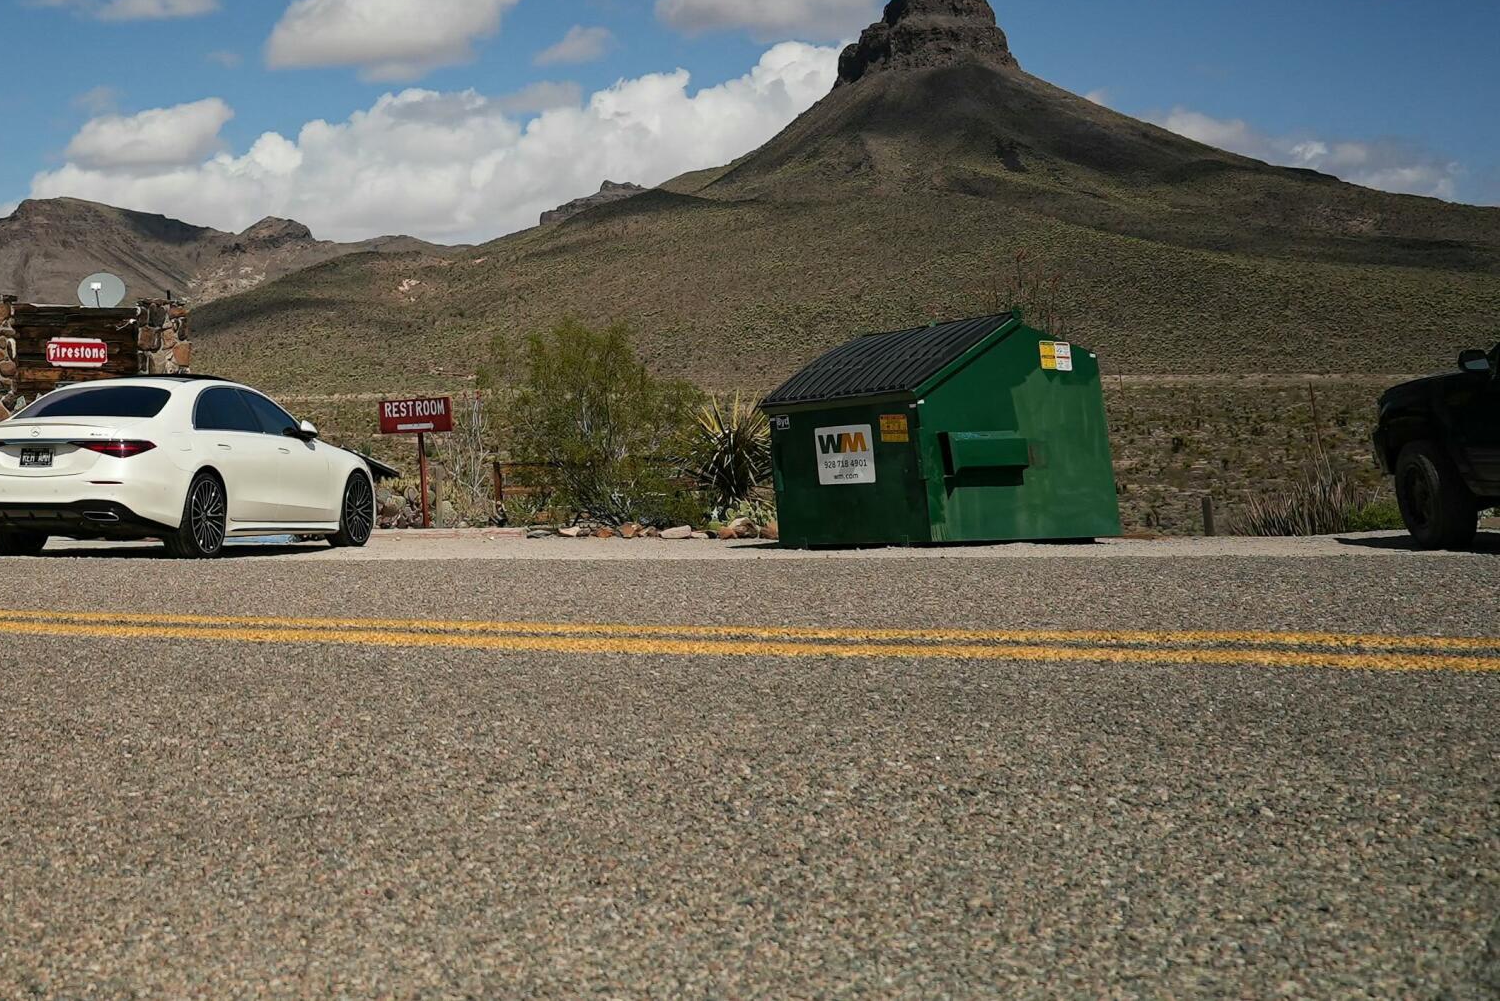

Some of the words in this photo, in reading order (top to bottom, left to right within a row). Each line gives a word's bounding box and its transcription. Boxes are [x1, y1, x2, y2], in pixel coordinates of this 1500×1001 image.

[47, 343, 106, 360] Firestone
[817, 431, 868, 455] WM
[824, 460, 836, 469] 928
